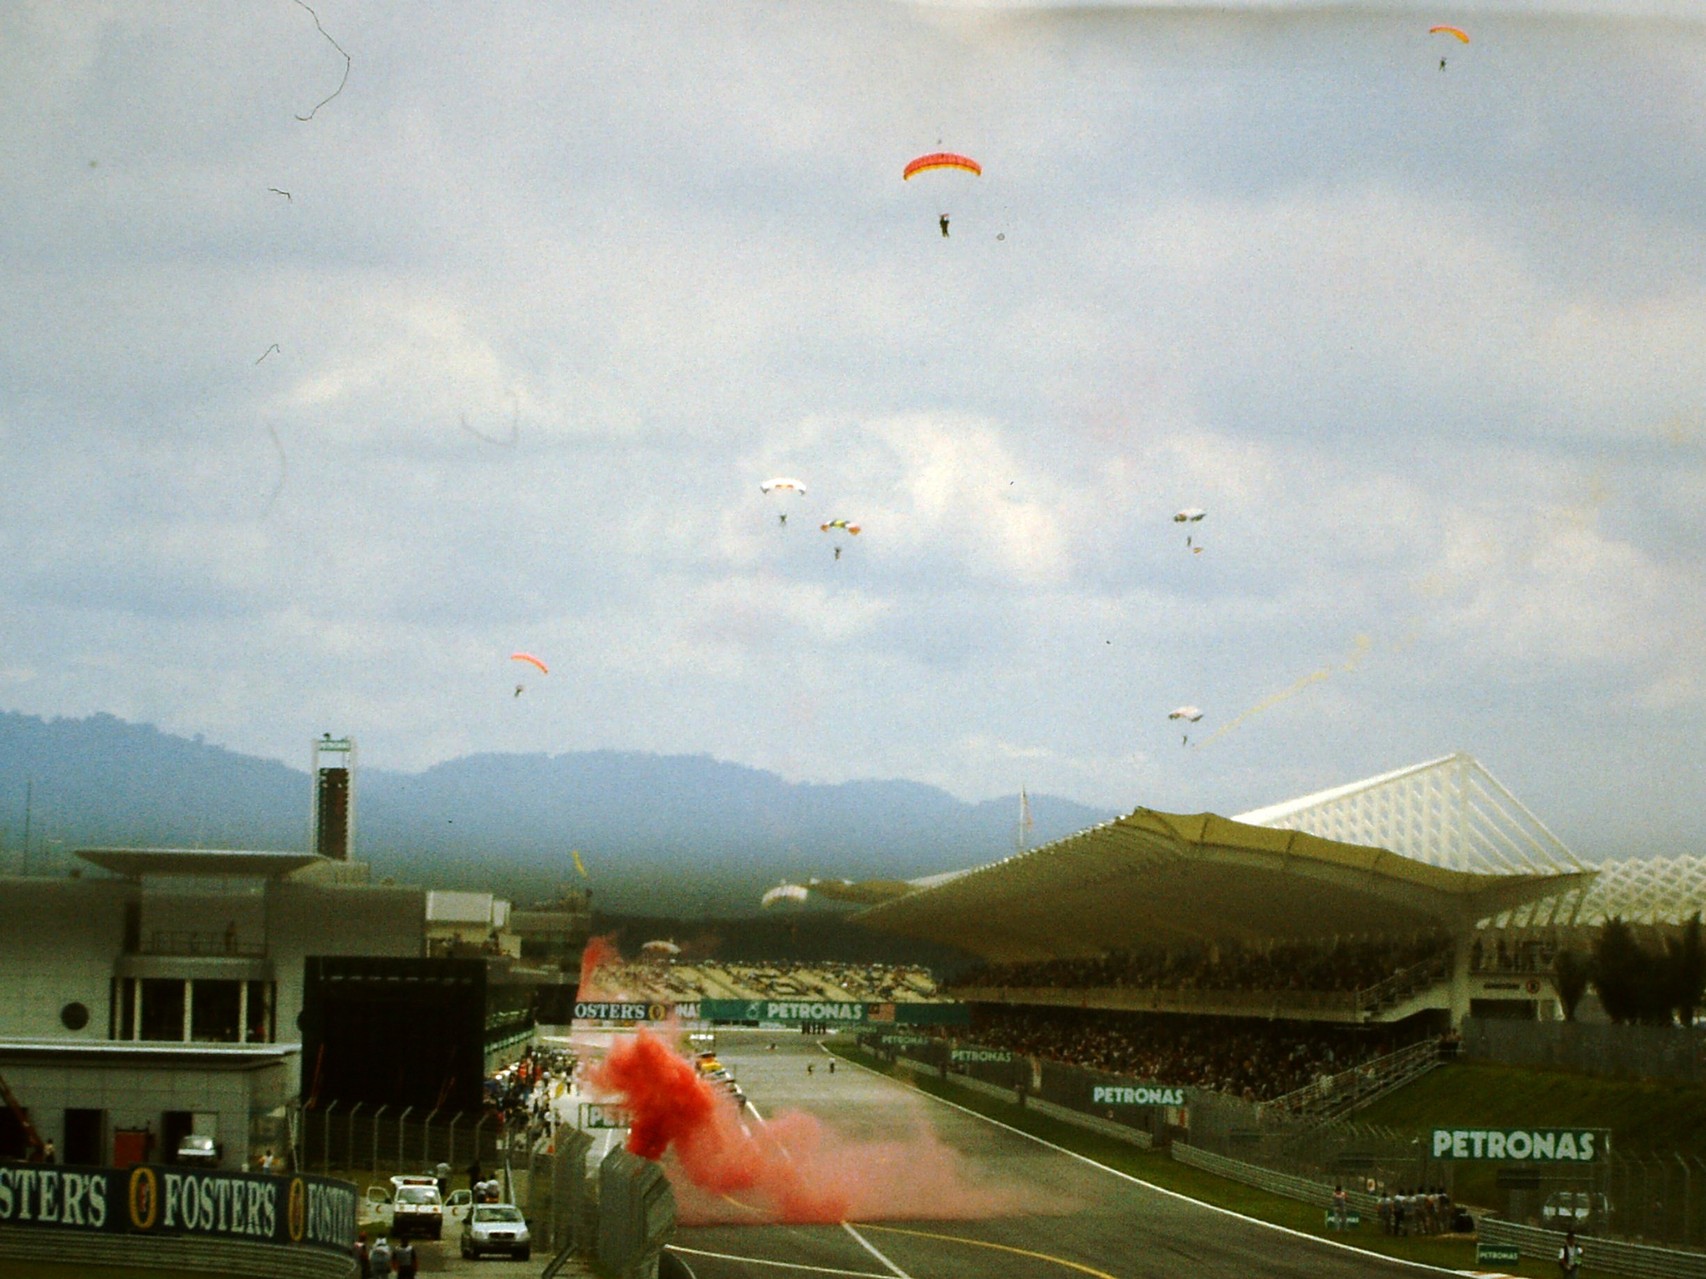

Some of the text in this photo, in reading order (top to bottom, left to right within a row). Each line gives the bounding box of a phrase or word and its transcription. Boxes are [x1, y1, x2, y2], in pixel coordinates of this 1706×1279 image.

[767, 1001, 863, 1020] PETRONAS
[951, 1050, 1012, 1063] PETRONAS
[1093, 1087, 1184, 1105] PETRONAS
[1432, 1129, 1595, 1161] PETRONAS
[163, 1172, 277, 1239] FOSTER'S
